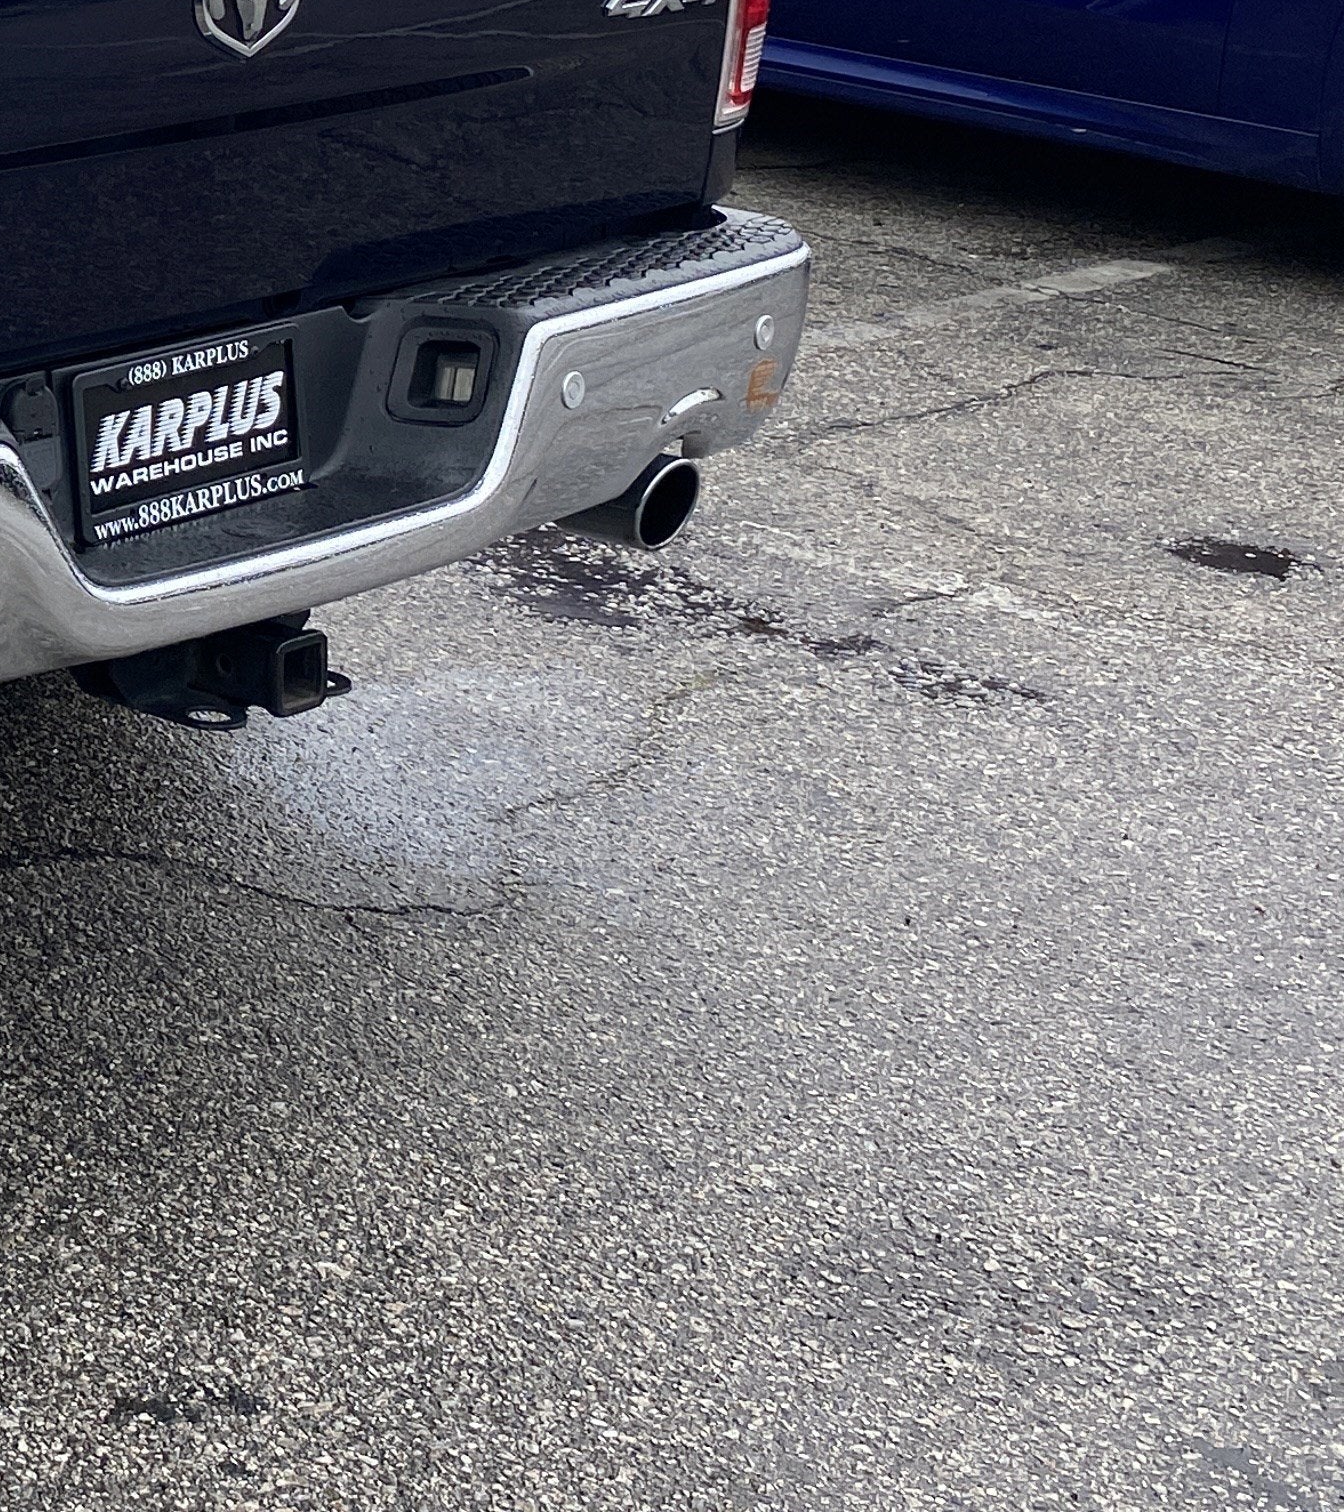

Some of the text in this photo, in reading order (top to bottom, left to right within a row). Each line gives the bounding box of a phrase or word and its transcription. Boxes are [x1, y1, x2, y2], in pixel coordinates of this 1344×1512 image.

[128, 339, 249, 386] (888) KARPLUS
[89, 370, 284, 474] KARPLUS
[90, 428, 288, 495] WAREHOUSE INC
